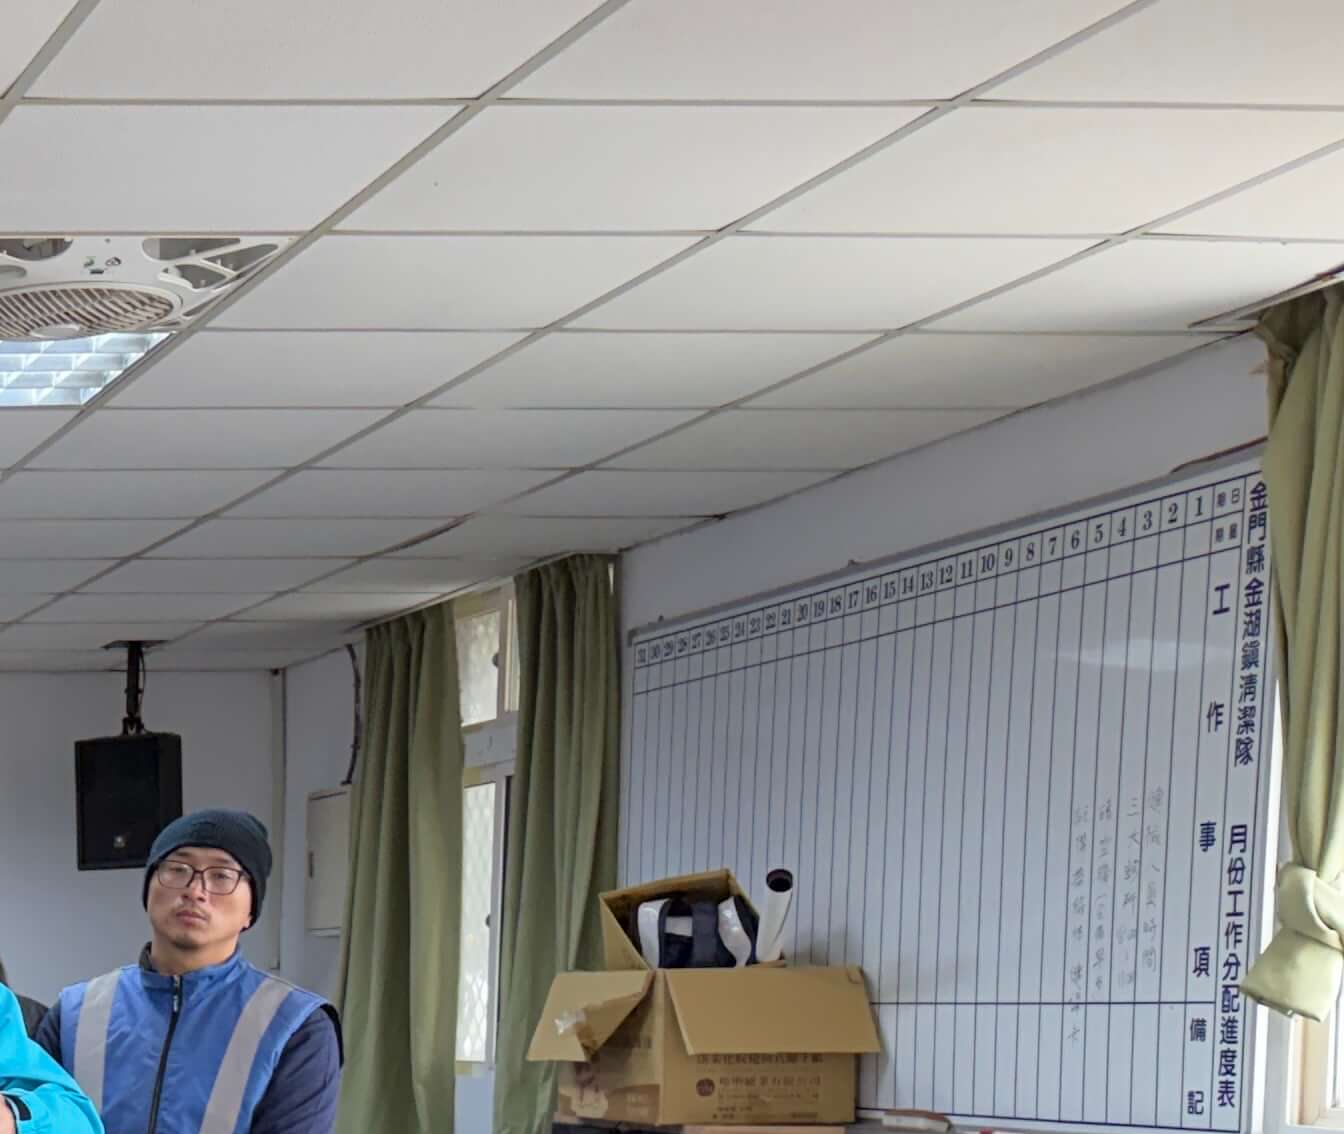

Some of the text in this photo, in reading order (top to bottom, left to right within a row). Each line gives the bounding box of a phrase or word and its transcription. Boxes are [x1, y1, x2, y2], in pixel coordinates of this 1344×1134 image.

[734, 623, 745, 637] 24
[749, 619, 761, 633] 23
[765, 614, 776, 630] 22
[781, 609, 792, 624] 21
[796, 604, 808, 622] 20
[813, 600, 825, 618] 19
[830, 595, 842, 613] 18
[847, 590, 859, 608] 17
[865, 585, 878, 603] 16
[883, 580, 896, 599] 15
[901, 575, 915, 595] 14
[920, 570, 934, 590] 13
[939, 565, 953, 584] 12
[960, 559, 974, 579] 11
[981, 553, 995, 574] 10
[1004, 547, 1014, 568] 9
[1026, 542, 1035, 562] 8
[1049, 536, 1058, 556] 7
[1071, 530, 1080, 549] 6
[1093, 524, 1104, 544] 5
[1117, 517, 1127, 537] 4
[1143, 510, 1153, 531] 3
[1168, 502, 1178, 524] 2
[1194, 495, 1203, 517] 1
